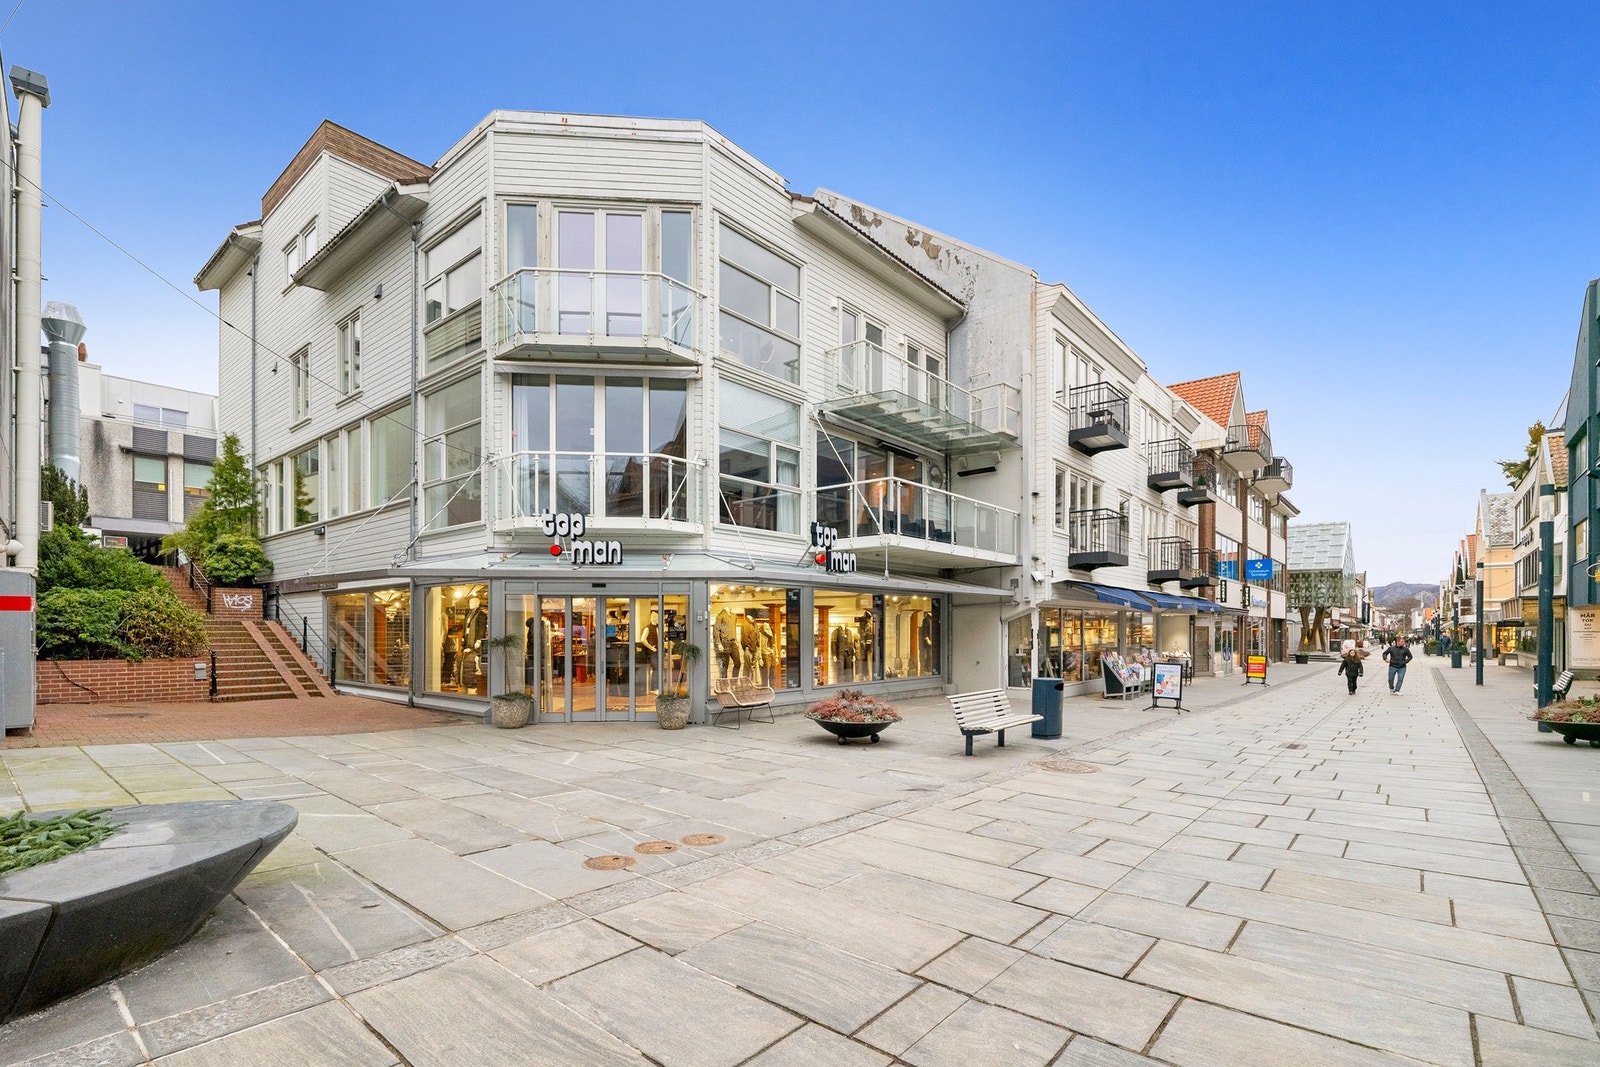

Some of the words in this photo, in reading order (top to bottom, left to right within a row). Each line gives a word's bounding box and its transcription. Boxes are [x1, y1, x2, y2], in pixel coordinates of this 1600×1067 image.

[541, 508, 585, 541] top
[811, 521, 838, 549] top
[571, 540, 623, 565] man
[826, 551, 857, 573] man
